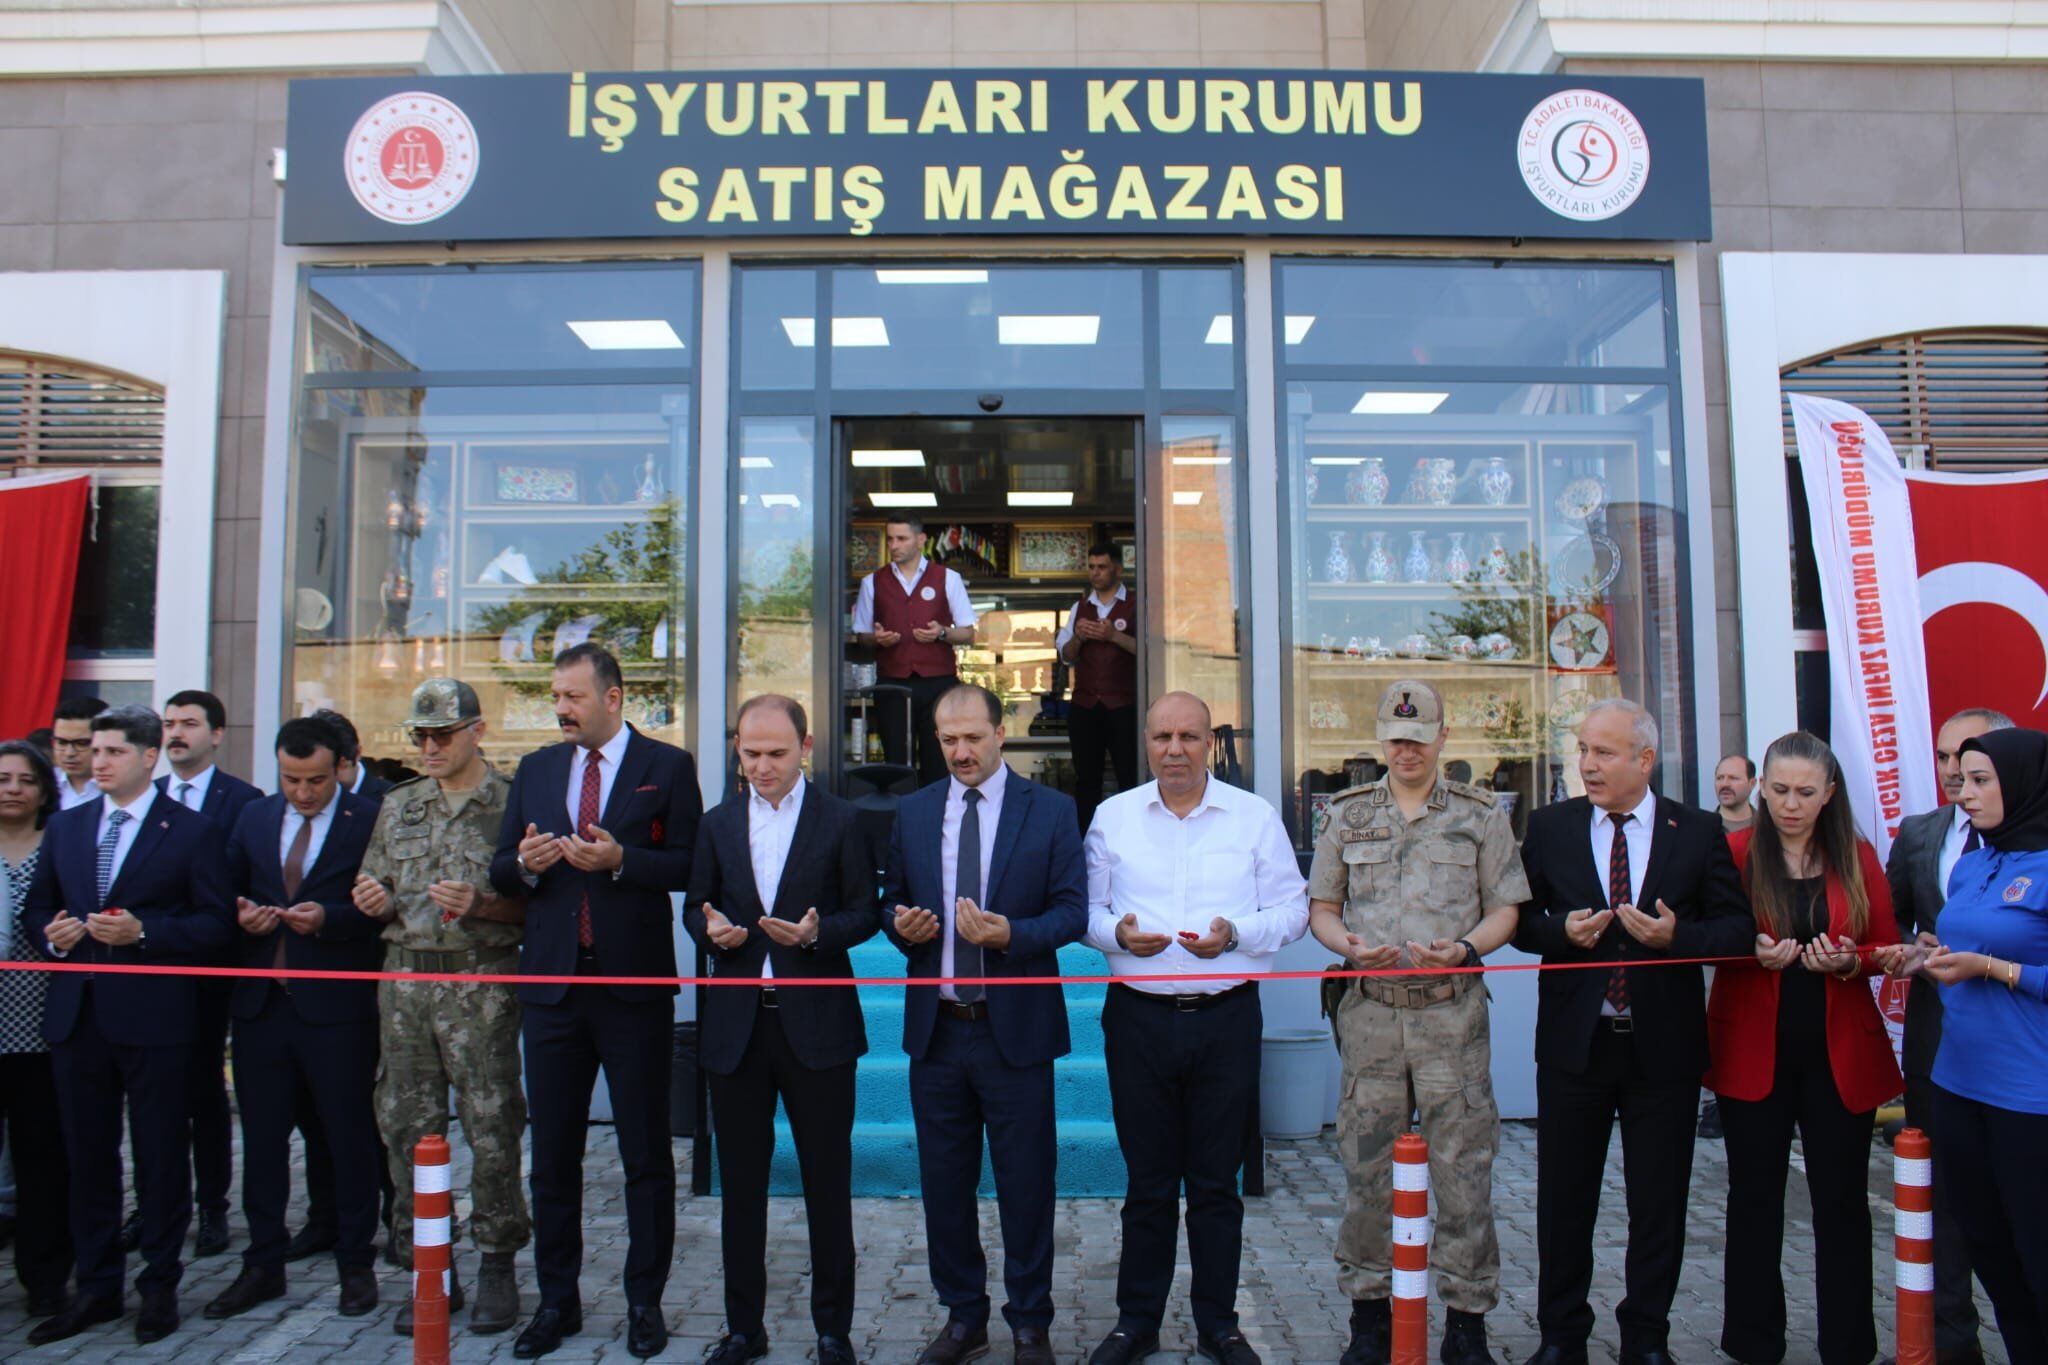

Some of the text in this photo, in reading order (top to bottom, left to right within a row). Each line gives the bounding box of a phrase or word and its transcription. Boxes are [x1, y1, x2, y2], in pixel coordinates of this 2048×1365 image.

[569, 69, 1422, 153] İŞYURTLARI KURUMU
[1535, 95, 1580, 129] ADALET
[656, 149, 1344, 236] SATIŞ MAĞAZASI
[1602, 161, 1644, 211] KURUMU
